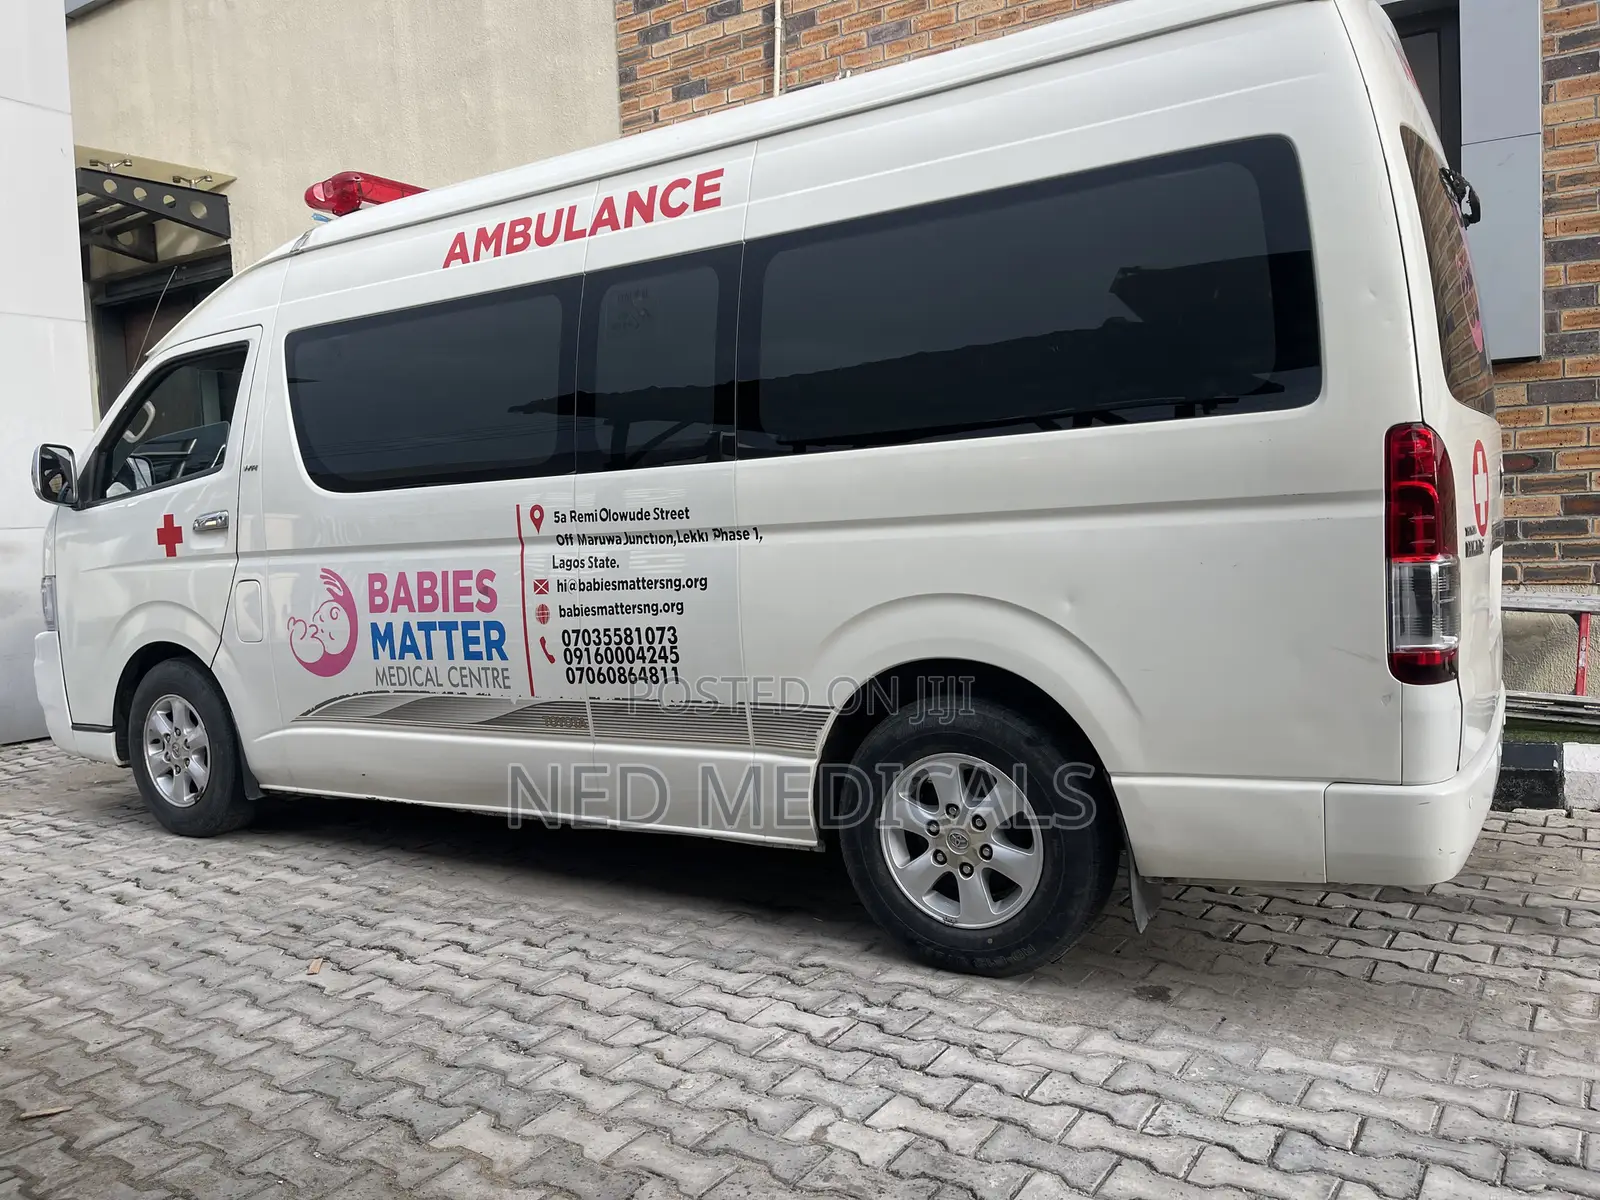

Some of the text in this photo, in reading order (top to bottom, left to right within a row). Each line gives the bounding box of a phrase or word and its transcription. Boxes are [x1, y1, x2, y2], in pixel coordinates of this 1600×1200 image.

[442, 168, 725, 269] AMBULANCE
[554, 507, 690, 524] 5a Remi Olowude Street
[556, 533, 574, 547] Off
[713, 527, 750, 541] Phase
[552, 555, 620, 571] Lagos State.
[368, 569, 498, 614] BABIES
[556, 575, 708, 595] hi@babiesmattersng.org
[559, 601, 684, 618] babiesmattersng.org
[370, 620, 509, 661] MATTER
[561, 626, 678, 647] 07035581073
[563, 646, 680, 665] 09160004245
[375, 665, 511, 690] MEDICAL CENTRE
[566, 666, 680, 685] 07060864811
